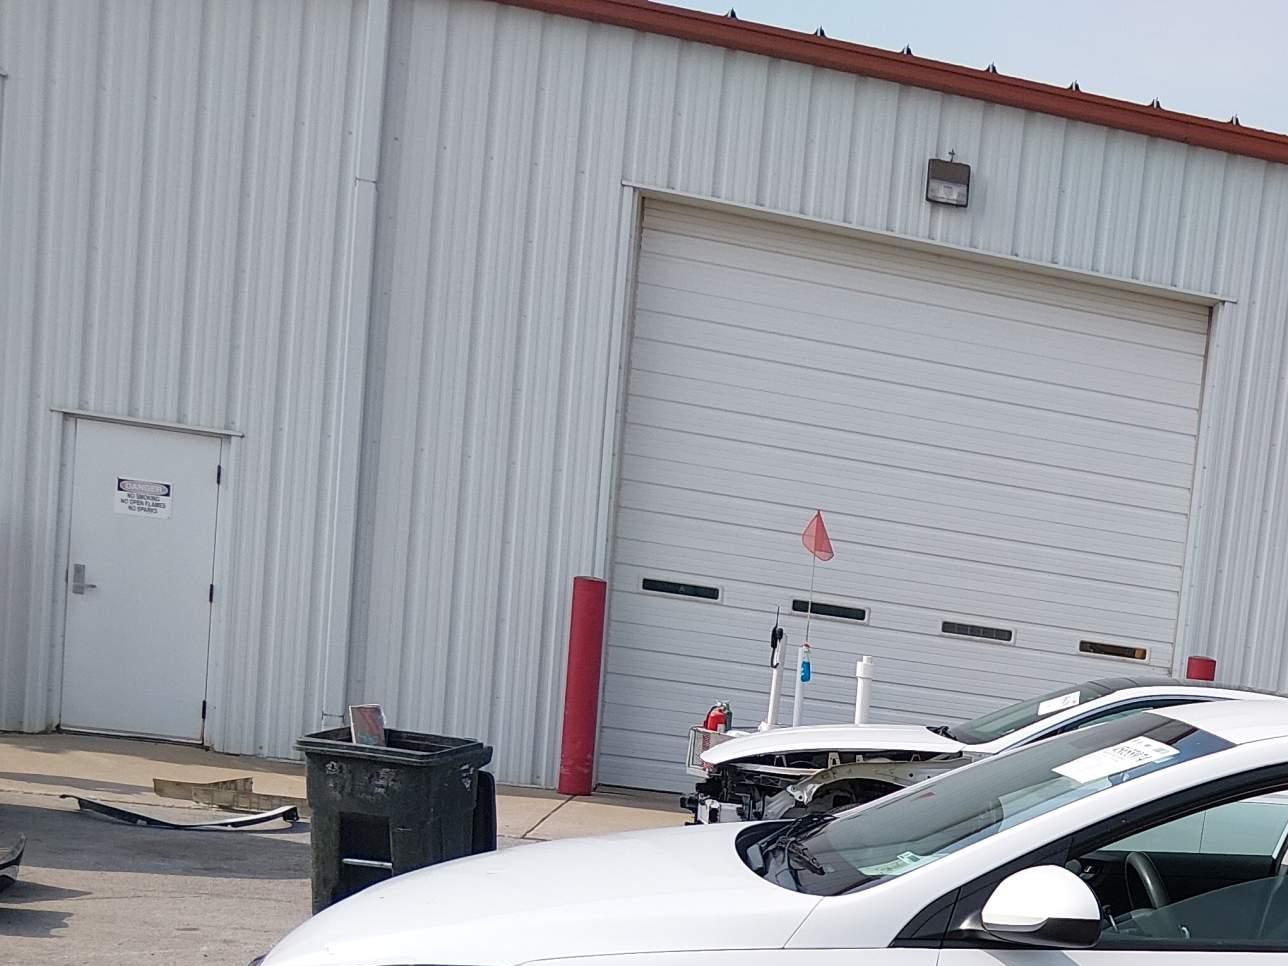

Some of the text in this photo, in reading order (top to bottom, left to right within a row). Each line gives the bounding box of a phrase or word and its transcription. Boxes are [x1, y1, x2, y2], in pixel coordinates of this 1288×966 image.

[124, 482, 163, 494] DANGER
[137, 494, 160, 502] SMOKING
[145, 500, 166, 508] FLAMES
[137, 506, 158, 514] SPARKS
